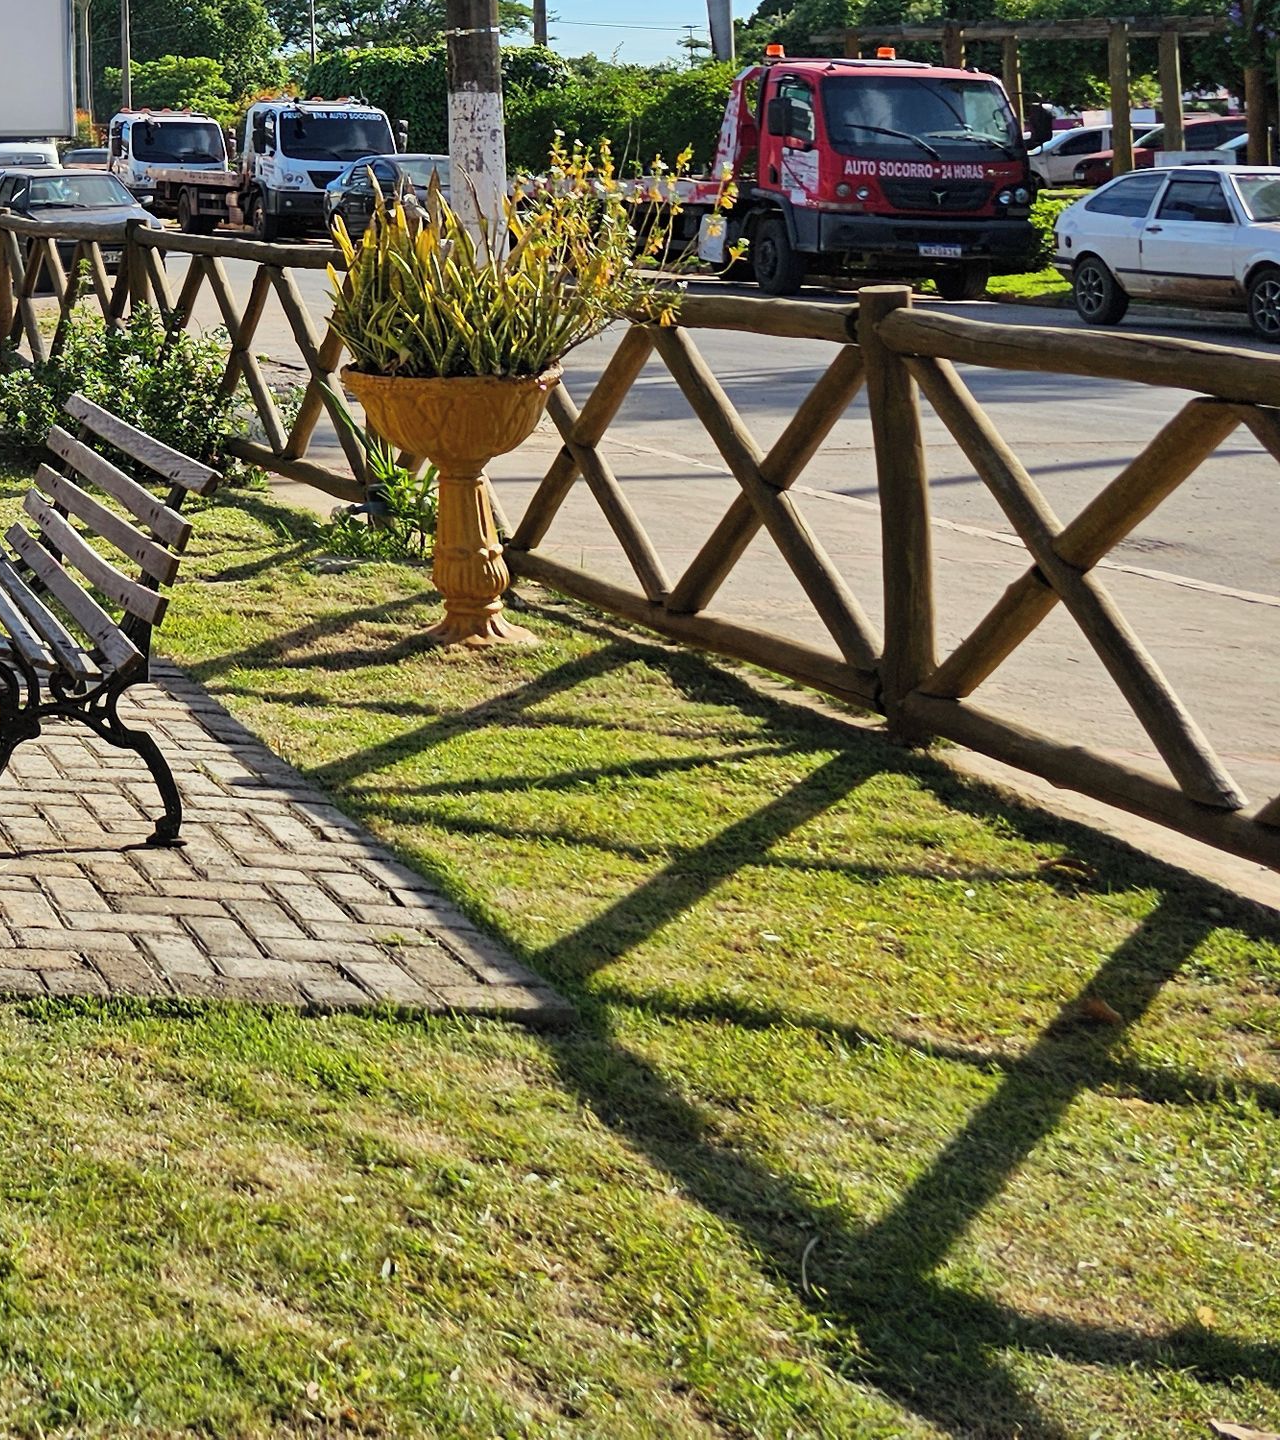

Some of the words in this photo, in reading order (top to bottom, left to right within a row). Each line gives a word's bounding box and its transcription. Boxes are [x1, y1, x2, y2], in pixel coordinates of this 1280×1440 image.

[349, 113, 382, 121] SOCORRO
[844, 160, 876, 176] AUTO
[879, 162, 933, 178] SOCORRO
[941, 165, 953, 179] 24
[954, 165, 984, 179] HORAS
